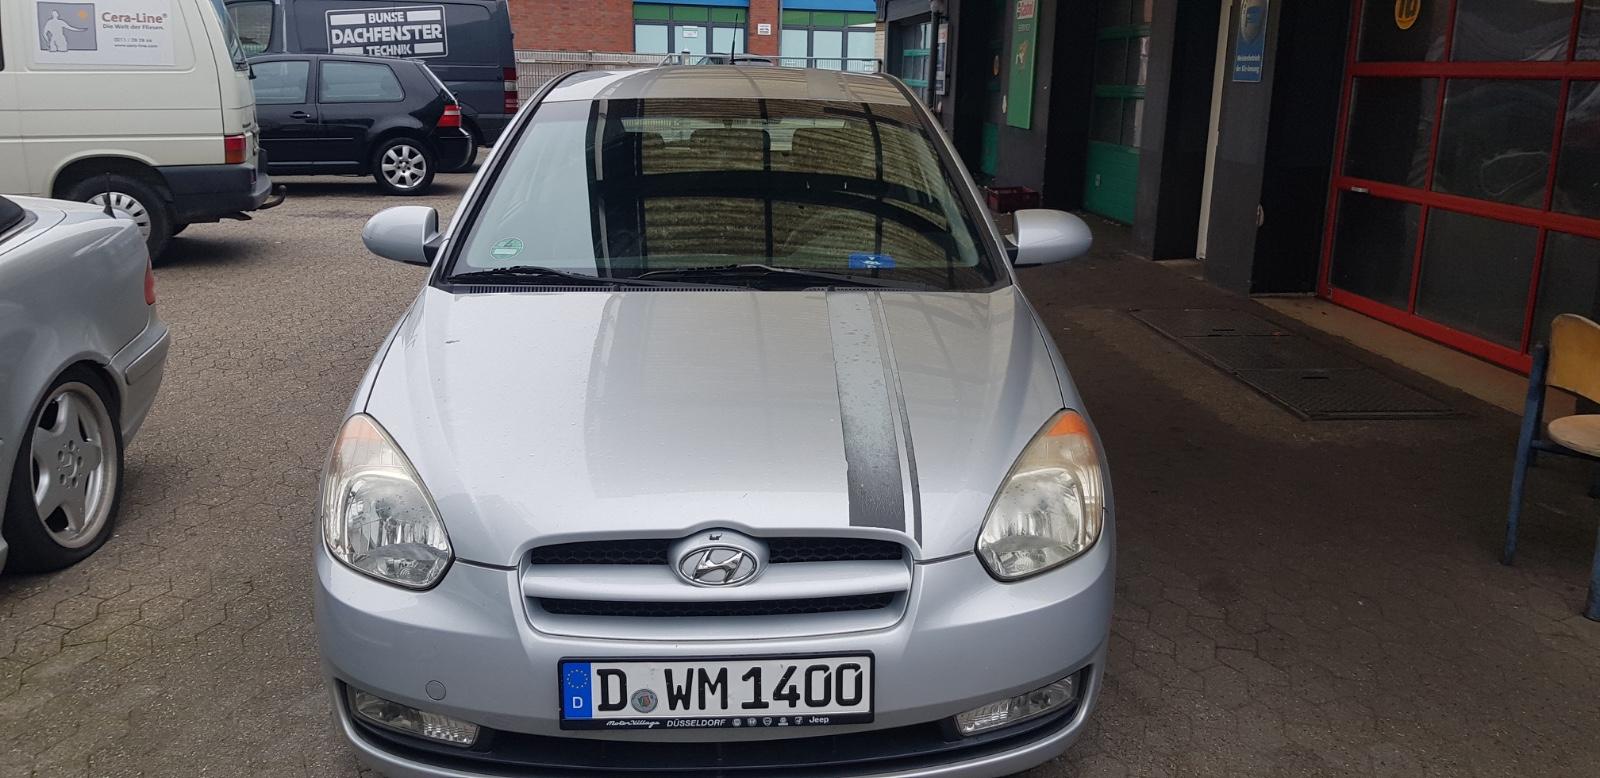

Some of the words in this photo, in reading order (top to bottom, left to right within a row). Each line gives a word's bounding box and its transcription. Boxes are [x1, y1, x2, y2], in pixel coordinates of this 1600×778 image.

[368, 12, 404, 23] BUNSE
[331, 24, 442, 45] DACHFENSTER
[366, 44, 412, 56] TECHNIK
[597, 668, 628, 711] D
[664, 667, 728, 711] WM
[741, 663, 863, 710] 1400
[572, 697, 583, 709] D
[667, 719, 726, 727] DÜSSELDORF
[809, 716, 829, 724] Jeep
